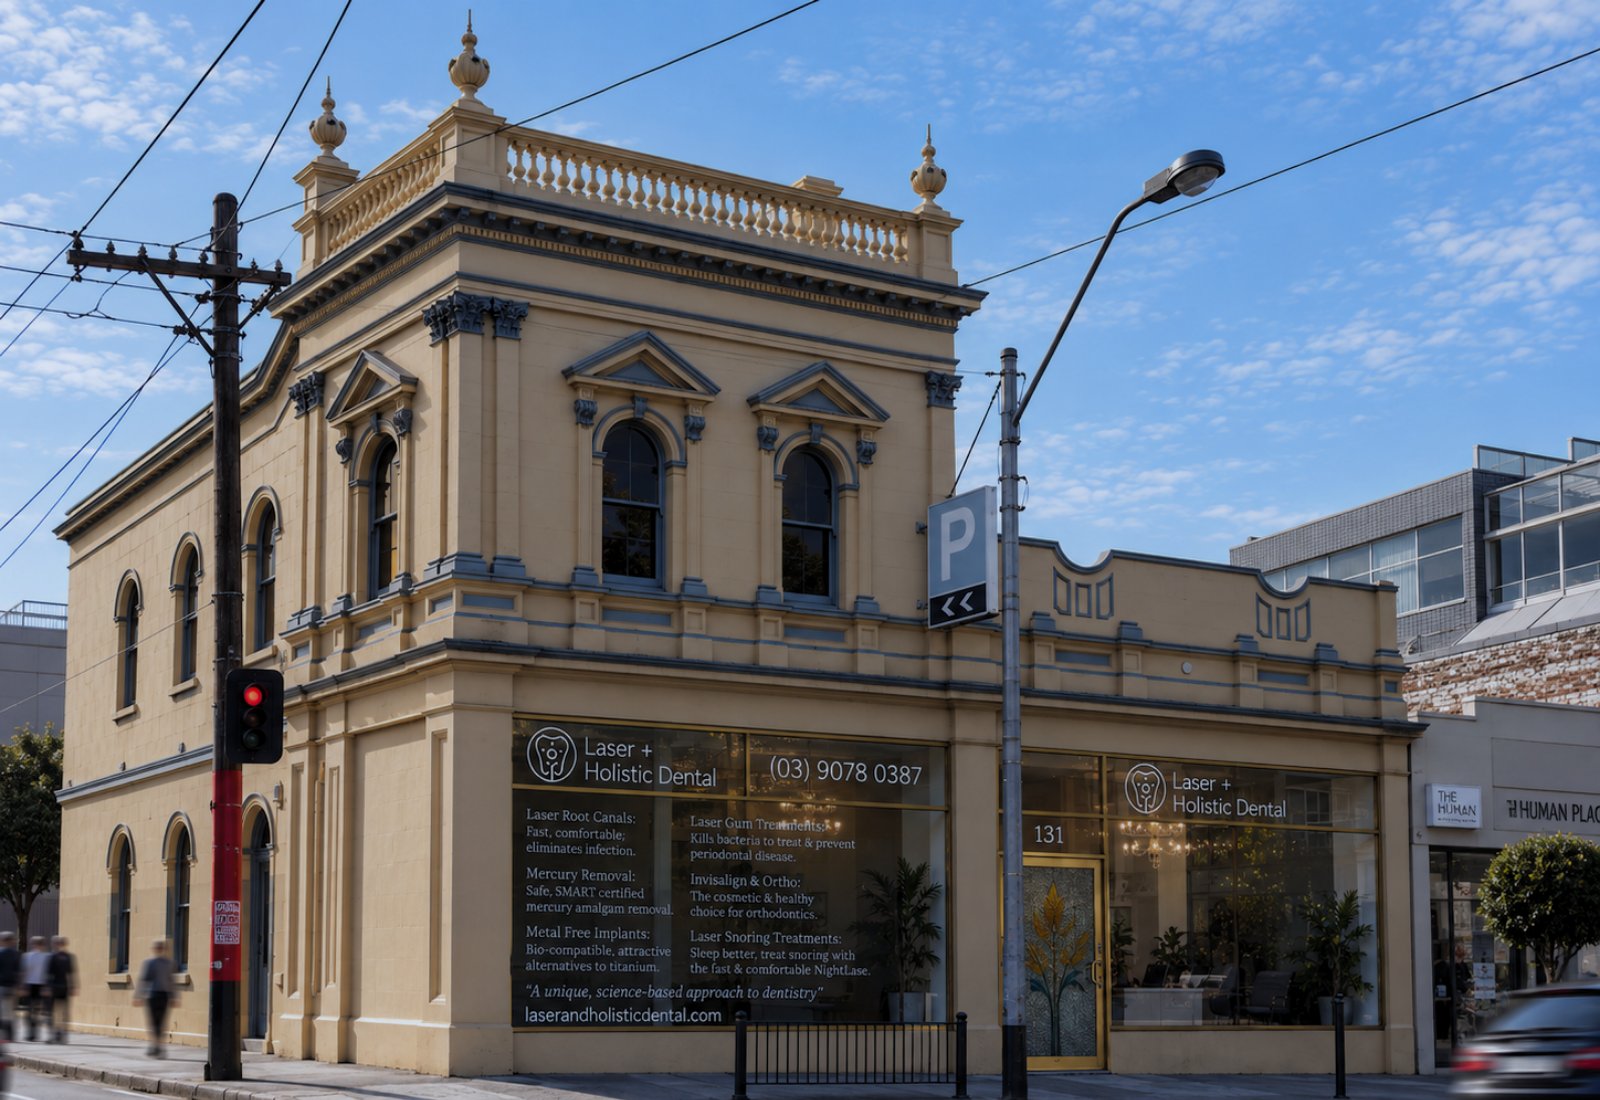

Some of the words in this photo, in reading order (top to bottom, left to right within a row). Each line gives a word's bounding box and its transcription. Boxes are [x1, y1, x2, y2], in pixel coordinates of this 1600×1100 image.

[941, 506, 975, 581] P
[585, 737, 635, 757] Laser
[642, 745, 652, 757] +
[585, 762, 653, 783] Holistic
[659, 766, 716, 786] Dental
[770, 755, 810, 782] (03)
[817, 760, 867, 782] 9078
[874, 764, 922, 785] 0387
[1173, 771, 1216, 791] Laser
[1221, 779, 1231, 791] +
[1438, 790, 1457, 803] THE
[1173, 795, 1232, 815] Holistic
[1237, 799, 1286, 818] Dental
[1520, 800, 1567, 821] HUMAN
[526, 808, 559, 821] Laser
[562, 810, 589, 823] Root
[593, 811, 636, 824] Canals:
[690, 815, 722, 828] Laser
[725, 817, 753, 829] Gum
[526, 826, 552, 838] Fast,
[1034, 825, 1063, 844] 131
[526, 841, 582, 854] eliminates
[585, 843, 636, 856] infection.
[690, 832, 714, 844] Kills
[717, 833, 760, 846] bacteria
[763, 837, 774, 846] to
[777, 837, 802, 848] treat
[805, 838, 813, 848] &
[816, 839, 855, 850] prevent
[690, 848, 752, 861] periodontal
[526, 867, 578, 883] Mercury
[581, 869, 635, 882] Removal:
[690, 873, 747, 889] Invisalign
[750, 875, 759, 887] &
[762, 875, 801, 888] Ortho:
[526, 885, 552, 898] Safe,
[555, 886, 596, 897] SMART
[598, 887, 644, 898] certified
[690, 891, 711, 902] The
[713, 892, 761, 903] cosmetic
[764, 893, 772, 903] &
[775, 893, 814, 906] healthy
[526, 903, 573, 915] mercury
[575, 902, 624, 916] amalgam
[628, 904, 674, 915] removal.
[690, 906, 725, 917] choice
[728, 906, 743, 918] for
[746, 908, 818, 920] orthodontics.
[526, 925, 561, 938] Metal
[565, 926, 590, 938] Free
[594, 927, 650, 942] Implants:
[690, 930, 722, 942] Laser
[725, 931, 770, 946] Snoring
[773, 932, 841, 944] Treatments:
[526, 944, 615, 958] Bio-compatible,
[618, 946, 671, 956] attractive
[690, 947, 719, 961] Sleep
[722, 948, 758, 960] better,
[761, 950, 786, 959] treat
[788, 950, 828, 962] snoring
[832, 950, 855, 961] with
[525, 959, 592, 971] alternatives
[595, 962, 607, 971] to
[609, 961, 660, 972] titanium.
[690, 964, 708, 974] the
[711, 963, 731, 974] fast
[734, 963, 743, 974] &
[746, 964, 811, 976] comfortable
[814, 965, 871, 978] NightLase.
[544, 986, 592, 1001] unique,
[596, 986, 683, 999] science-based
[686, 988, 744, 1001] approach
[748, 988, 759, 999] to
[525, 1006, 722, 1023] laserandholisticdental.com
